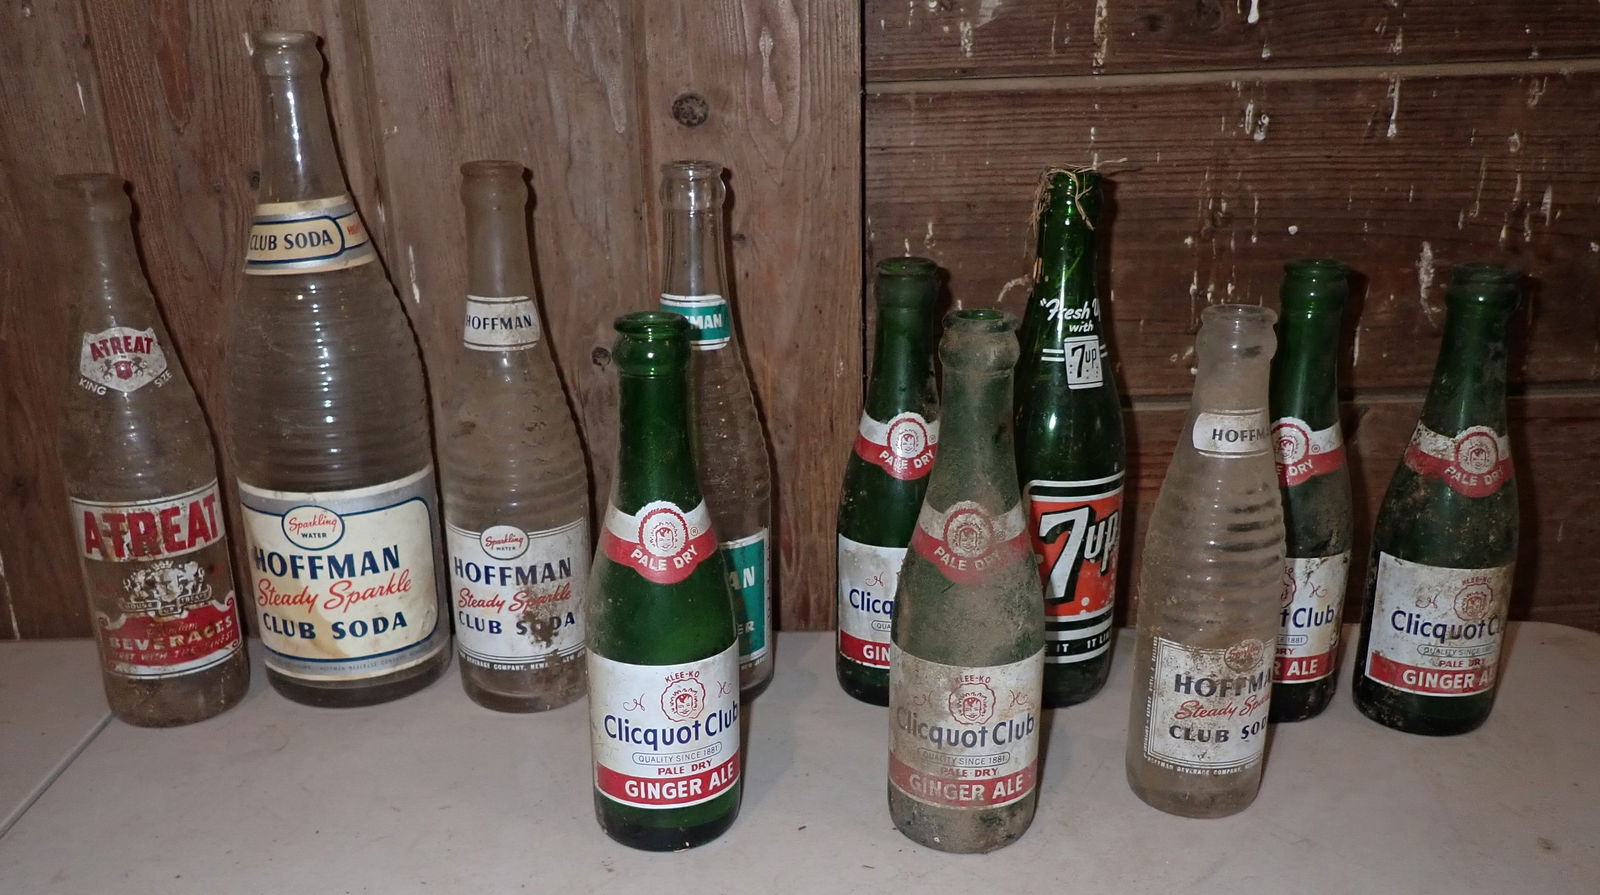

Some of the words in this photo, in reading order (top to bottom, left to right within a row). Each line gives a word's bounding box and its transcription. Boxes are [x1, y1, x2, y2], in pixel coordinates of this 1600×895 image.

[250, 234, 277, 251] CLUB
[284, 229, 334, 250] SODA
[466, 315, 532, 330] HOFFMAN
[1069, 320, 1094, 332] with
[79, 378, 107, 396] KING
[154, 370, 173, 388] SIZE
[880, 450, 908, 473] PALE
[913, 450, 934, 469] DRY
[1288, 459, 1314, 476] DRY
[1444, 466, 1478, 486] PALE
[288, 514, 338, 534] Sparkling
[485, 533, 523, 549] Sparkling
[254, 544, 401, 580] HOFFMAN
[631, 549, 667, 571] PALE
[673, 545, 698, 569] DRY
[934, 546, 967, 571] PALE
[454, 556, 572, 586] HOFFMAN
[258, 578, 318, 614] Steady
[324, 569, 412, 612] Sparkle
[458, 587, 505, 614] Steady
[509, 582, 572, 613] Sparkle
[849, 589, 894, 620] Clicq
[263, 613, 317, 640] CLUB
[332, 611, 407, 640] SODA
[458, 611, 502, 635] CLUB
[1292, 605, 1335, 628] Club
[1391, 610, 1486, 644] Clicquot
[863, 644, 890, 661] GIN
[1056, 643, 1069, 653] IT
[1087, 638, 1097, 648] IT
[1287, 659, 1319, 676] ALE
[1439, 660, 1464, 668] PALE
[664, 670, 700, 683] KLEE-KO
[1174, 668, 1272, 698] HOFFMA
[1402, 670, 1475, 689] GINGER
[1174, 699, 1238, 720] Steady
[604, 714, 701, 751] Clicquot
[705, 700, 738, 736] Club
[897, 707, 988, 749] Clicquot
[992, 713, 1035, 745] Club
[1169, 725, 1230, 743] CLUB
[638, 754, 673, 764] QUALITY
[676, 752, 700, 762] SINCE
[703, 745, 719, 755] 1881
[922, 750, 957, 765] QUALITY
[959, 757, 986, 766] SINCE
[989, 755, 1005, 764] 1881
[658, 766, 685, 776] PALE
[691, 759, 713, 772] DRY
[941, 766, 968, 777] PALE
[975, 767, 999, 777] DRY
[625, 778, 702, 800] GINGER
[709, 761, 734, 790] ALE
[909, 774, 985, 801] GINGER
[992, 774, 1024, 799] ALE
